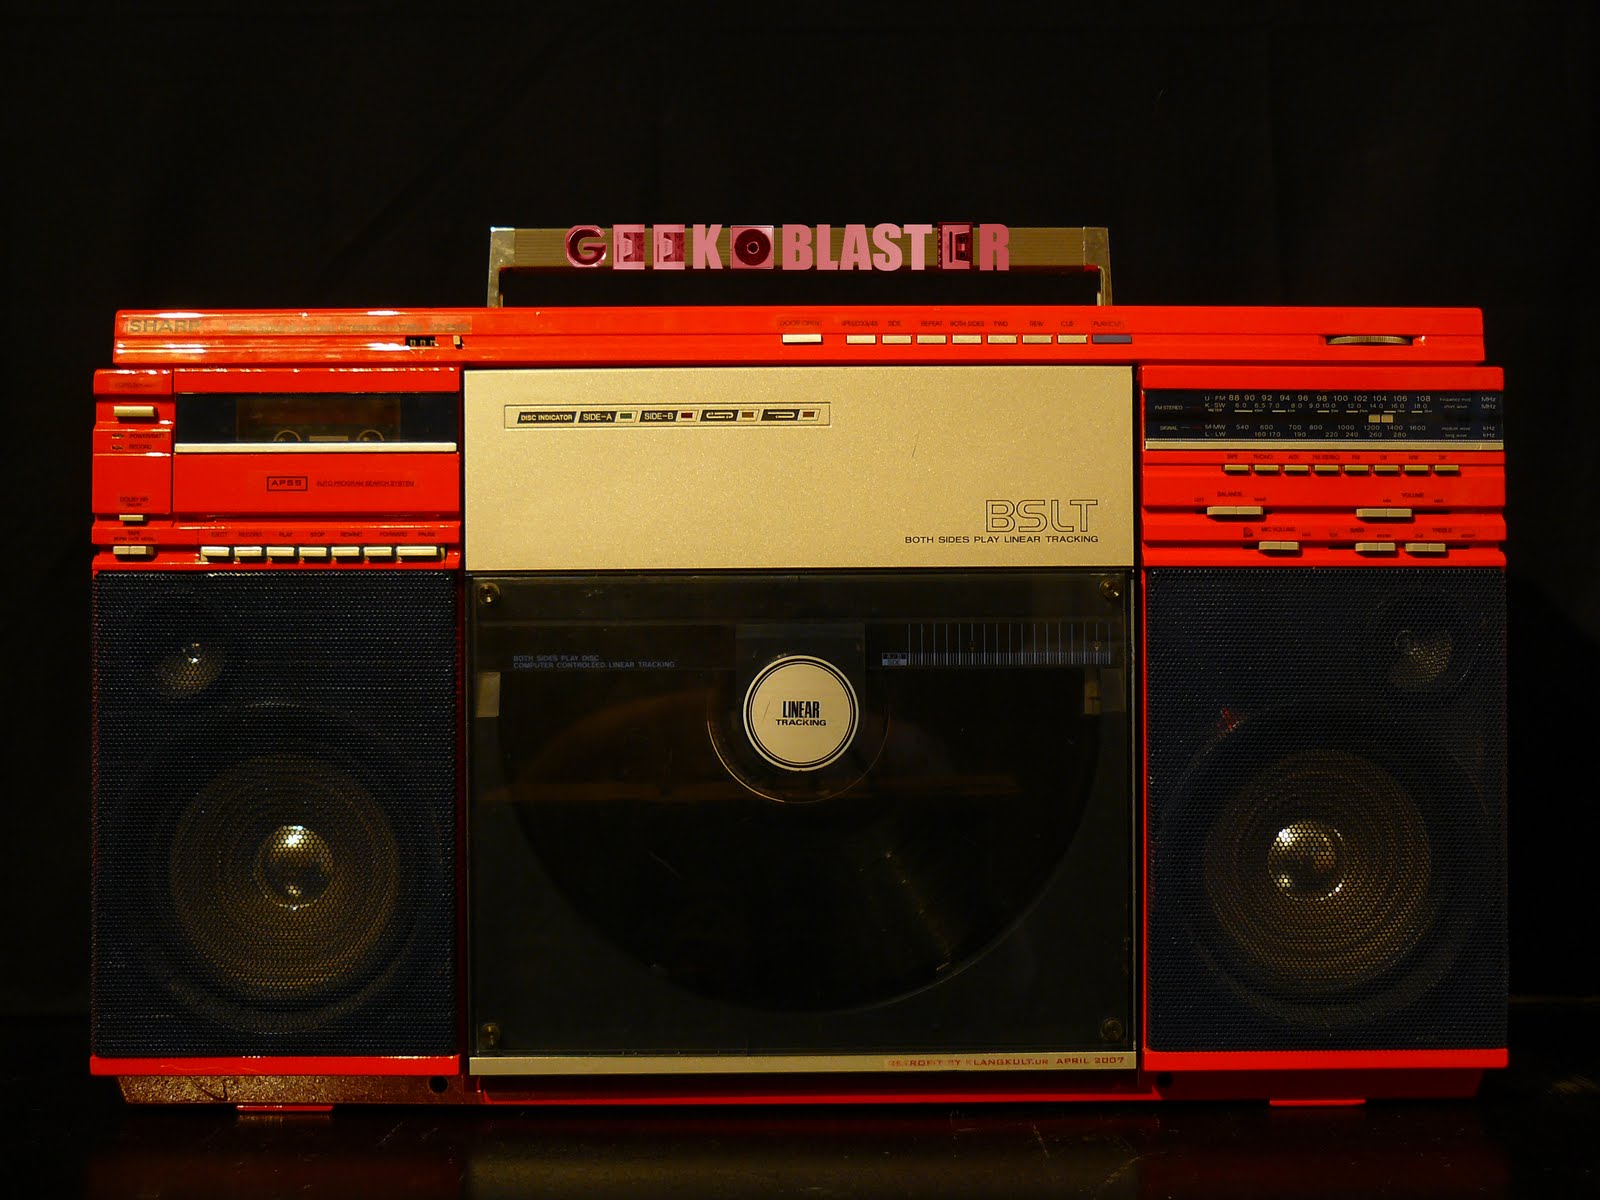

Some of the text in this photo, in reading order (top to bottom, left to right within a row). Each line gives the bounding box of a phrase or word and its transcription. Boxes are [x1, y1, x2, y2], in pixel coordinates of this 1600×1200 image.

[130, 320, 200, 332] SHARP
[986, 499, 1098, 533] BSLT
[905, 535, 1098, 544] BOTH SIDES PLAY LINEAR TRACKING
[782, 701, 820, 718] LINEAR
